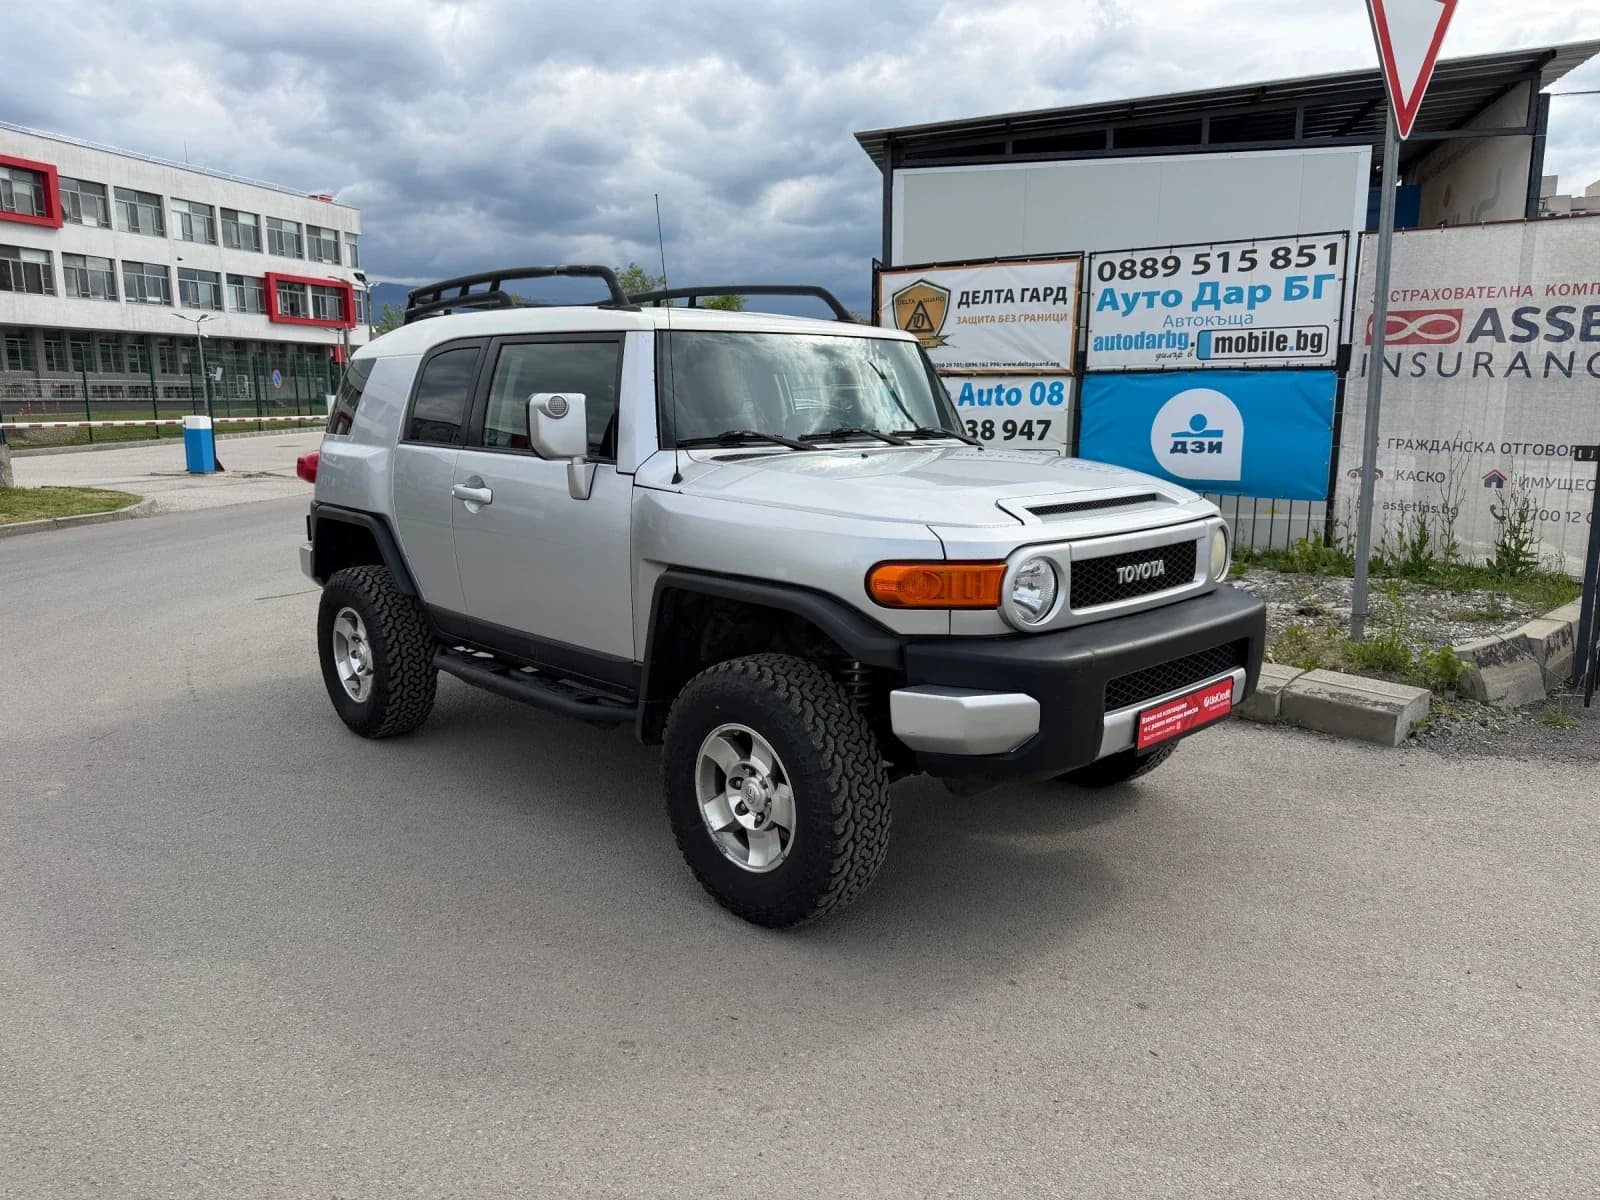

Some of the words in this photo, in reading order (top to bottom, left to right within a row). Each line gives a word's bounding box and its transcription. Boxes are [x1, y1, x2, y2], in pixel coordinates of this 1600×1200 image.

[1097, 254, 1181, 282] 0889
[1191, 248, 1258, 275] 515
[1269, 242, 1338, 270] 851
[957, 288, 1015, 309] ДЕЛТА
[1020, 286, 1068, 305] ГАРД
[1096, 287, 1183, 317] Ауто
[1191, 281, 1272, 312] Дар
[1283, 273, 1336, 302] БГ
[1390, 284, 1533, 302] СТРАХОВАТЕЛНА
[956, 315, 998, 325] ЗАЩИТА
[998, 314, 1017, 323] БЕЗ
[1018, 312, 1068, 324] ГРАНИЦИ
[1162, 313, 1254, 329] Автокъща
[1466, 305, 1600, 343] ASSE
[1214, 329, 1323, 354] mobile.bg
[957, 382, 1022, 407] Auto
[1029, 381, 1065, 407] 08
[1002, 419, 1052, 441] 947
[1170, 441, 1223, 454] ДЗИ
[1387, 438, 1495, 455] ГРАЖДАНСКА
[1396, 470, 1446, 483] КАСКО
[1116, 559, 1166, 585] TOYOTA
